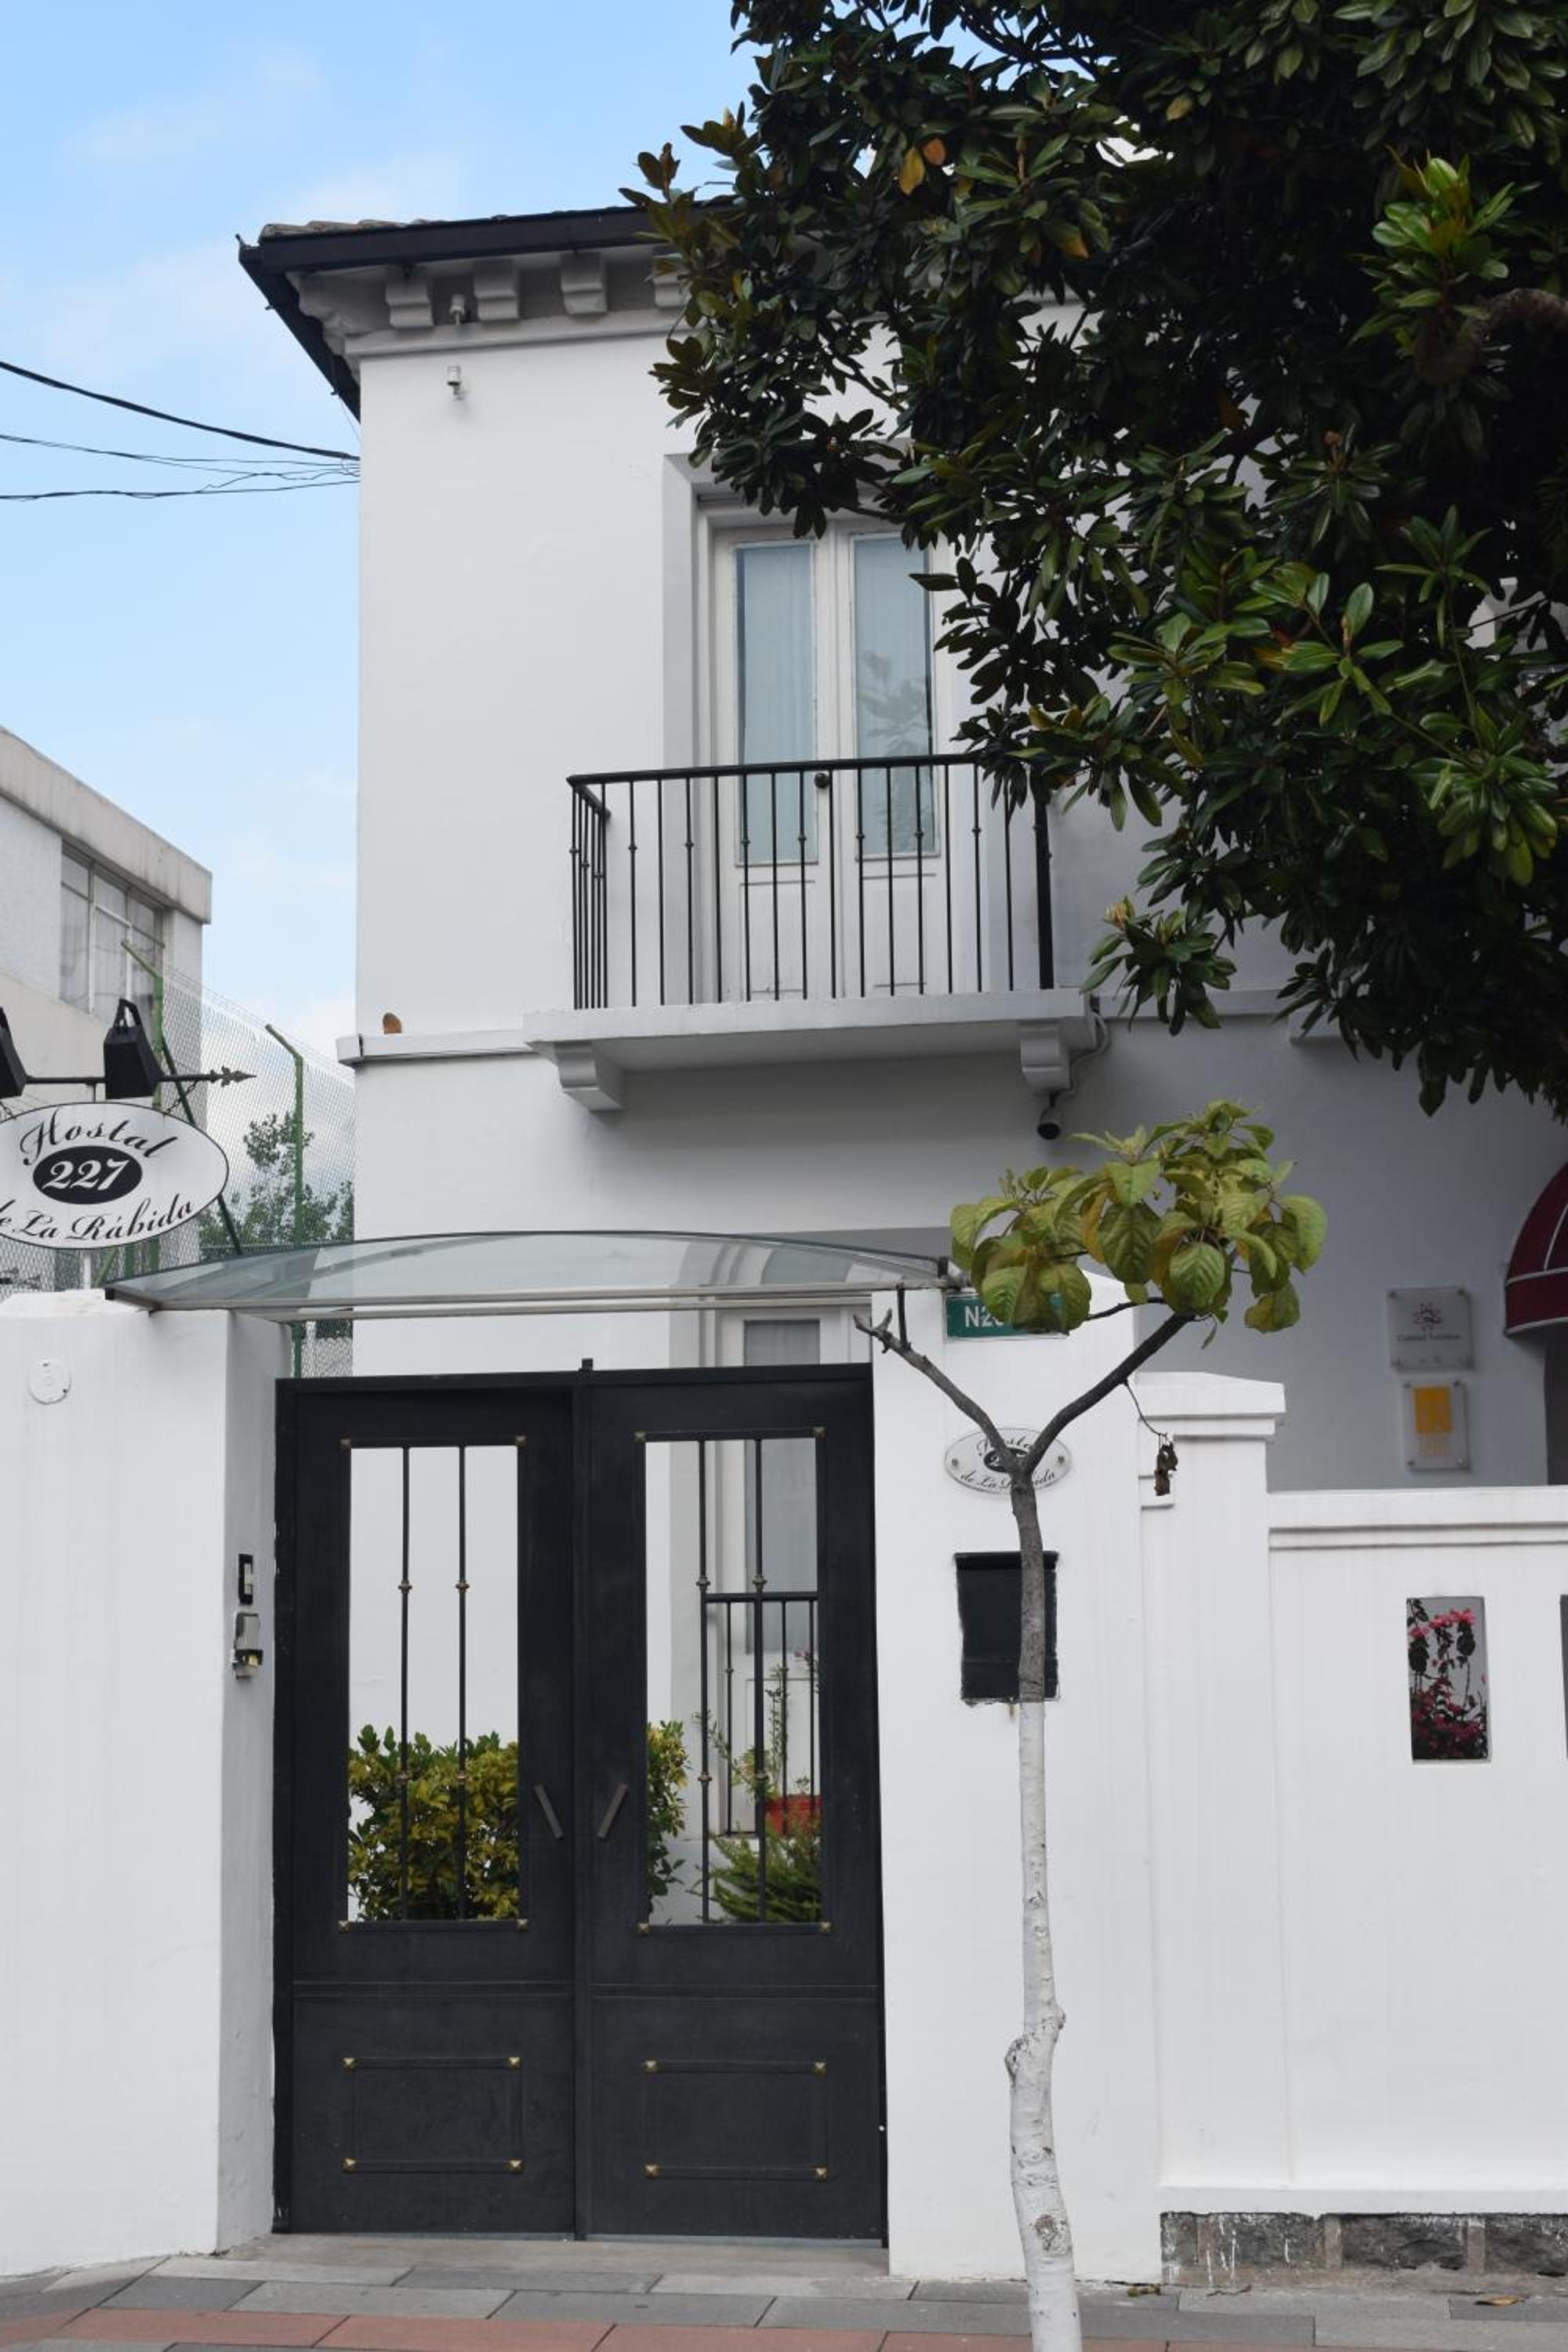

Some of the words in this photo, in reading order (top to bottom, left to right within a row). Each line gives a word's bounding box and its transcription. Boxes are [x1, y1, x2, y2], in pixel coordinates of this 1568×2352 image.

[20, 1108, 178, 1165] Hostal
[42, 1159, 130, 1190] 227
[20, 1210, 59, 1239] La
